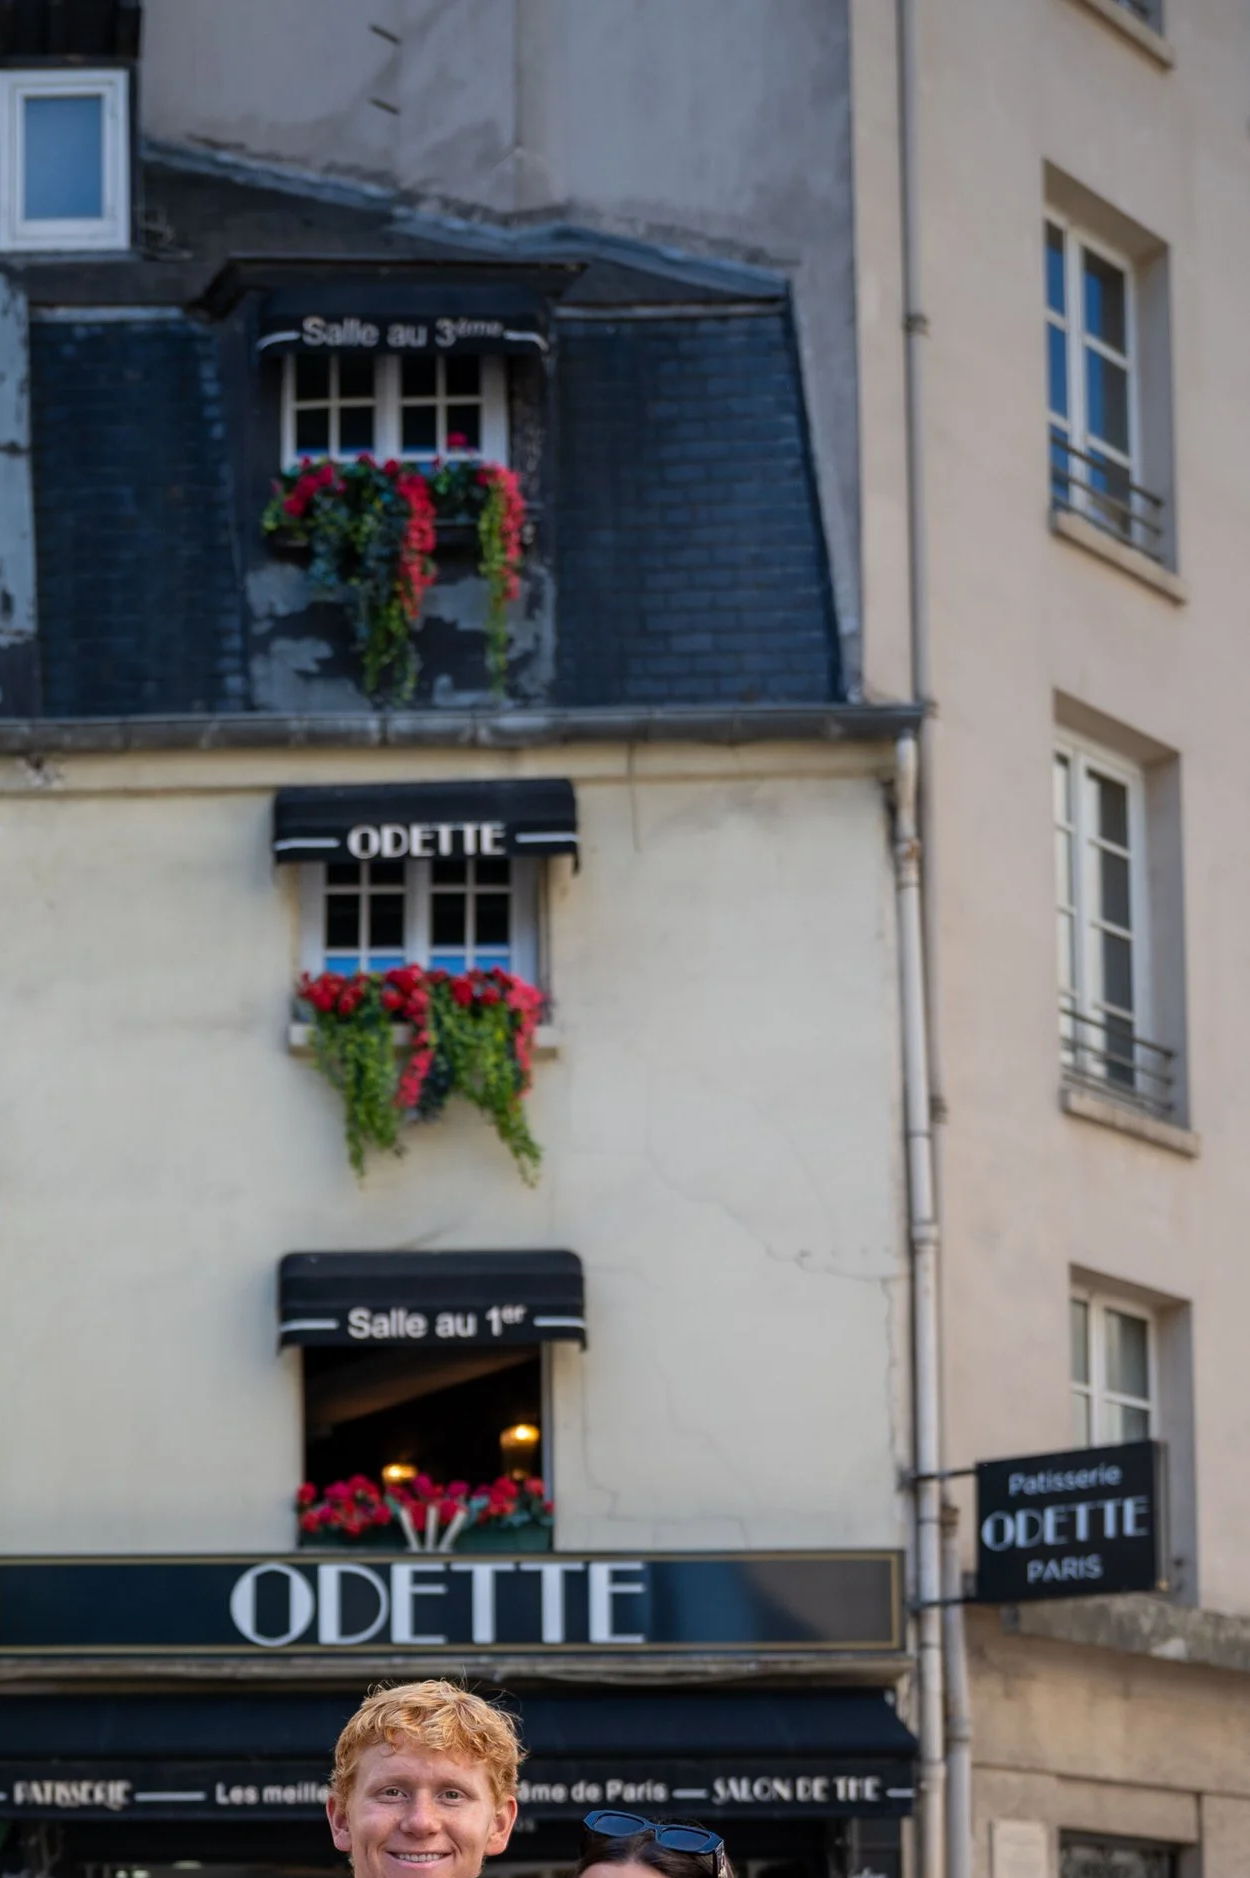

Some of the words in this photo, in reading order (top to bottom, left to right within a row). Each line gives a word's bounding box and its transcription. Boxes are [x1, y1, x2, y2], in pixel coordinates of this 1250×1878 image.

[302, 316, 379, 348] Salle
[387, 323, 427, 347] au
[347, 822, 505, 859] ODETTE
[347, 1307, 428, 1338] Salle
[435, 1312, 477, 1338] au
[1008, 1464, 1123, 1497] Patisserie
[981, 1496, 1150, 1551] ODETTE
[1027, 1554, 1103, 1584] PARIS
[229, 1561, 648, 1648] ODETTE
[13, 1780, 133, 1811] PATISSERIE
[215, 1781, 258, 1805] Les
[262, 1781, 330, 1804] meille
[570, 1780, 603, 1803] de
[605, 1779, 667, 1803] Paris
[711, 1776, 792, 1805] SALON
[795, 1777, 829, 1801] DE
